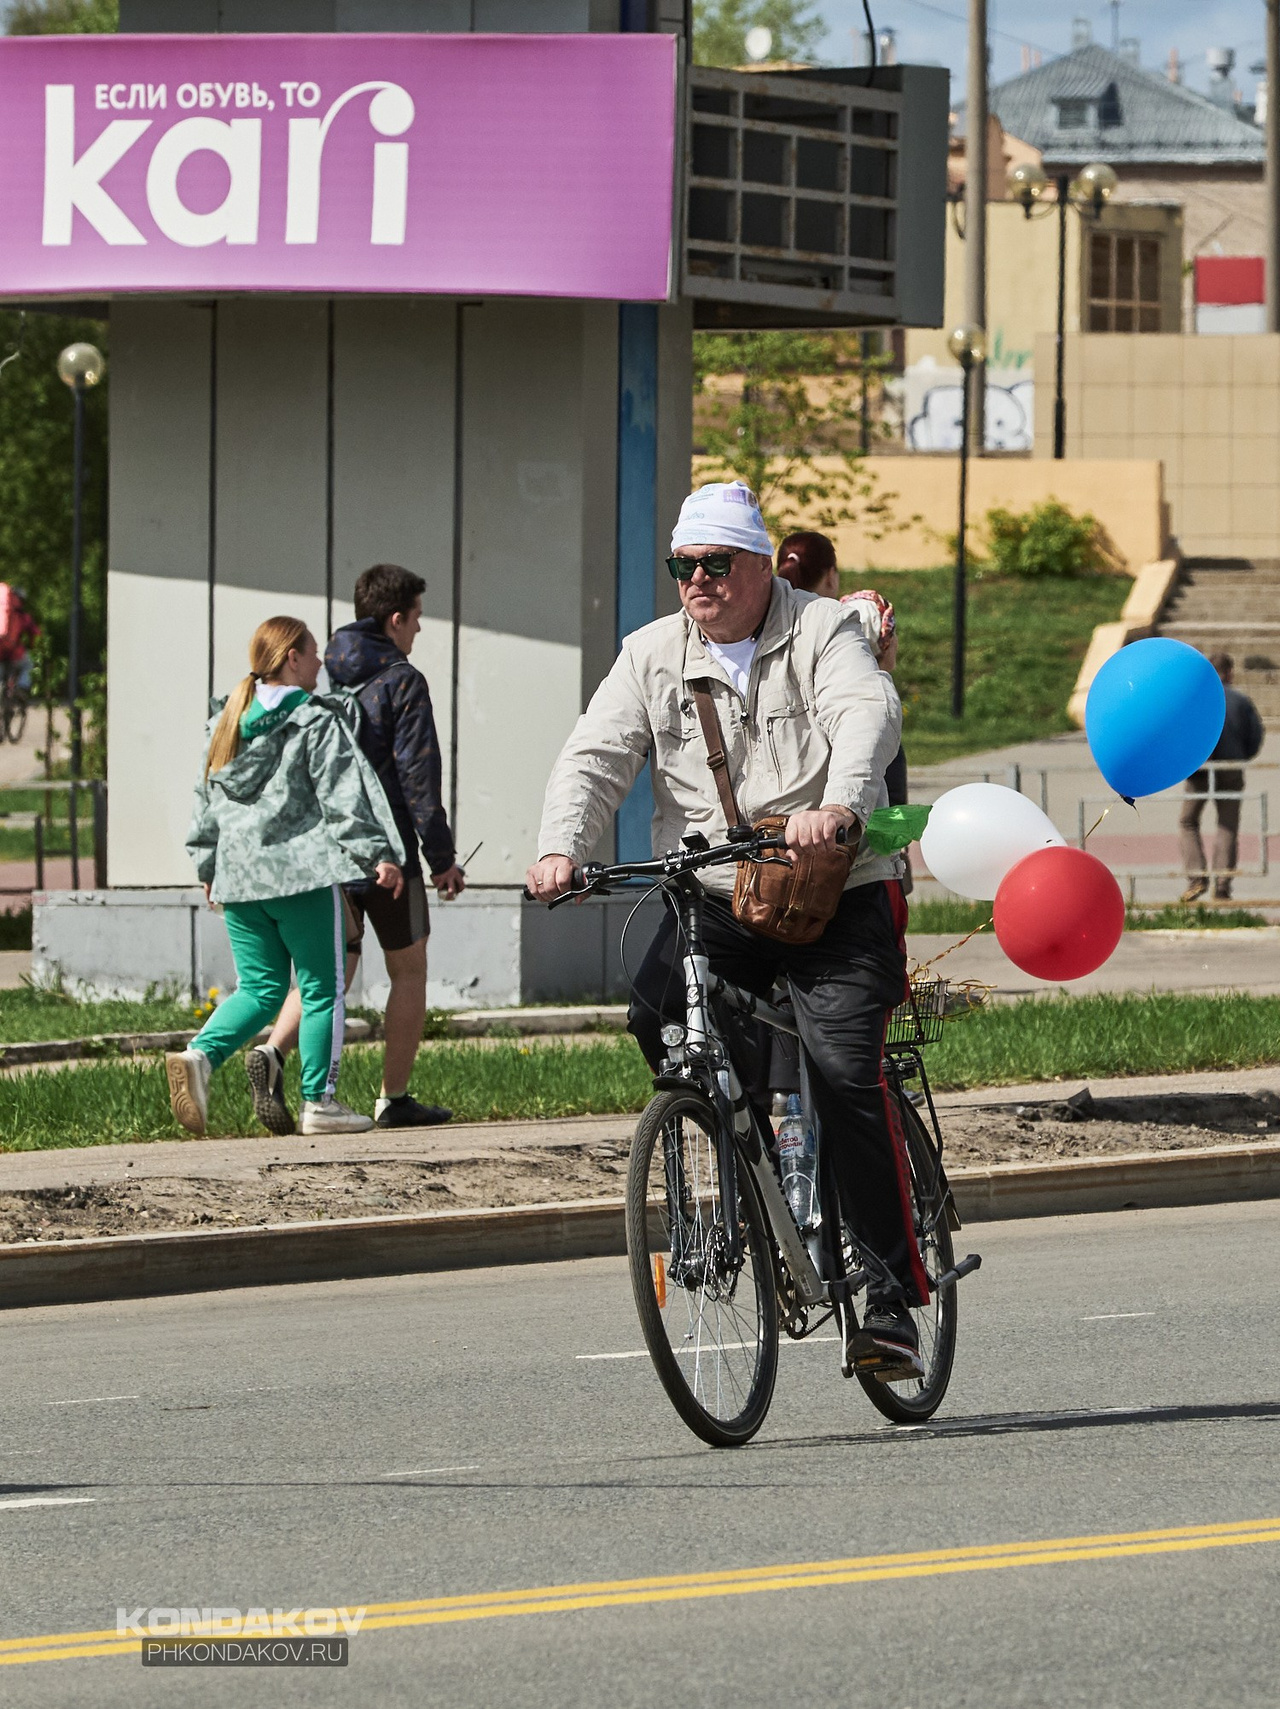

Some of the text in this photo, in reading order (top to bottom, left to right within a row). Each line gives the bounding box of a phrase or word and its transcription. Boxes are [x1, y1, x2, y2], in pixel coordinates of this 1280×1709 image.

[95, 82, 321, 111] ЕСЛИ ОБУВЬ, ТО
[41, 81, 415, 248] kari
